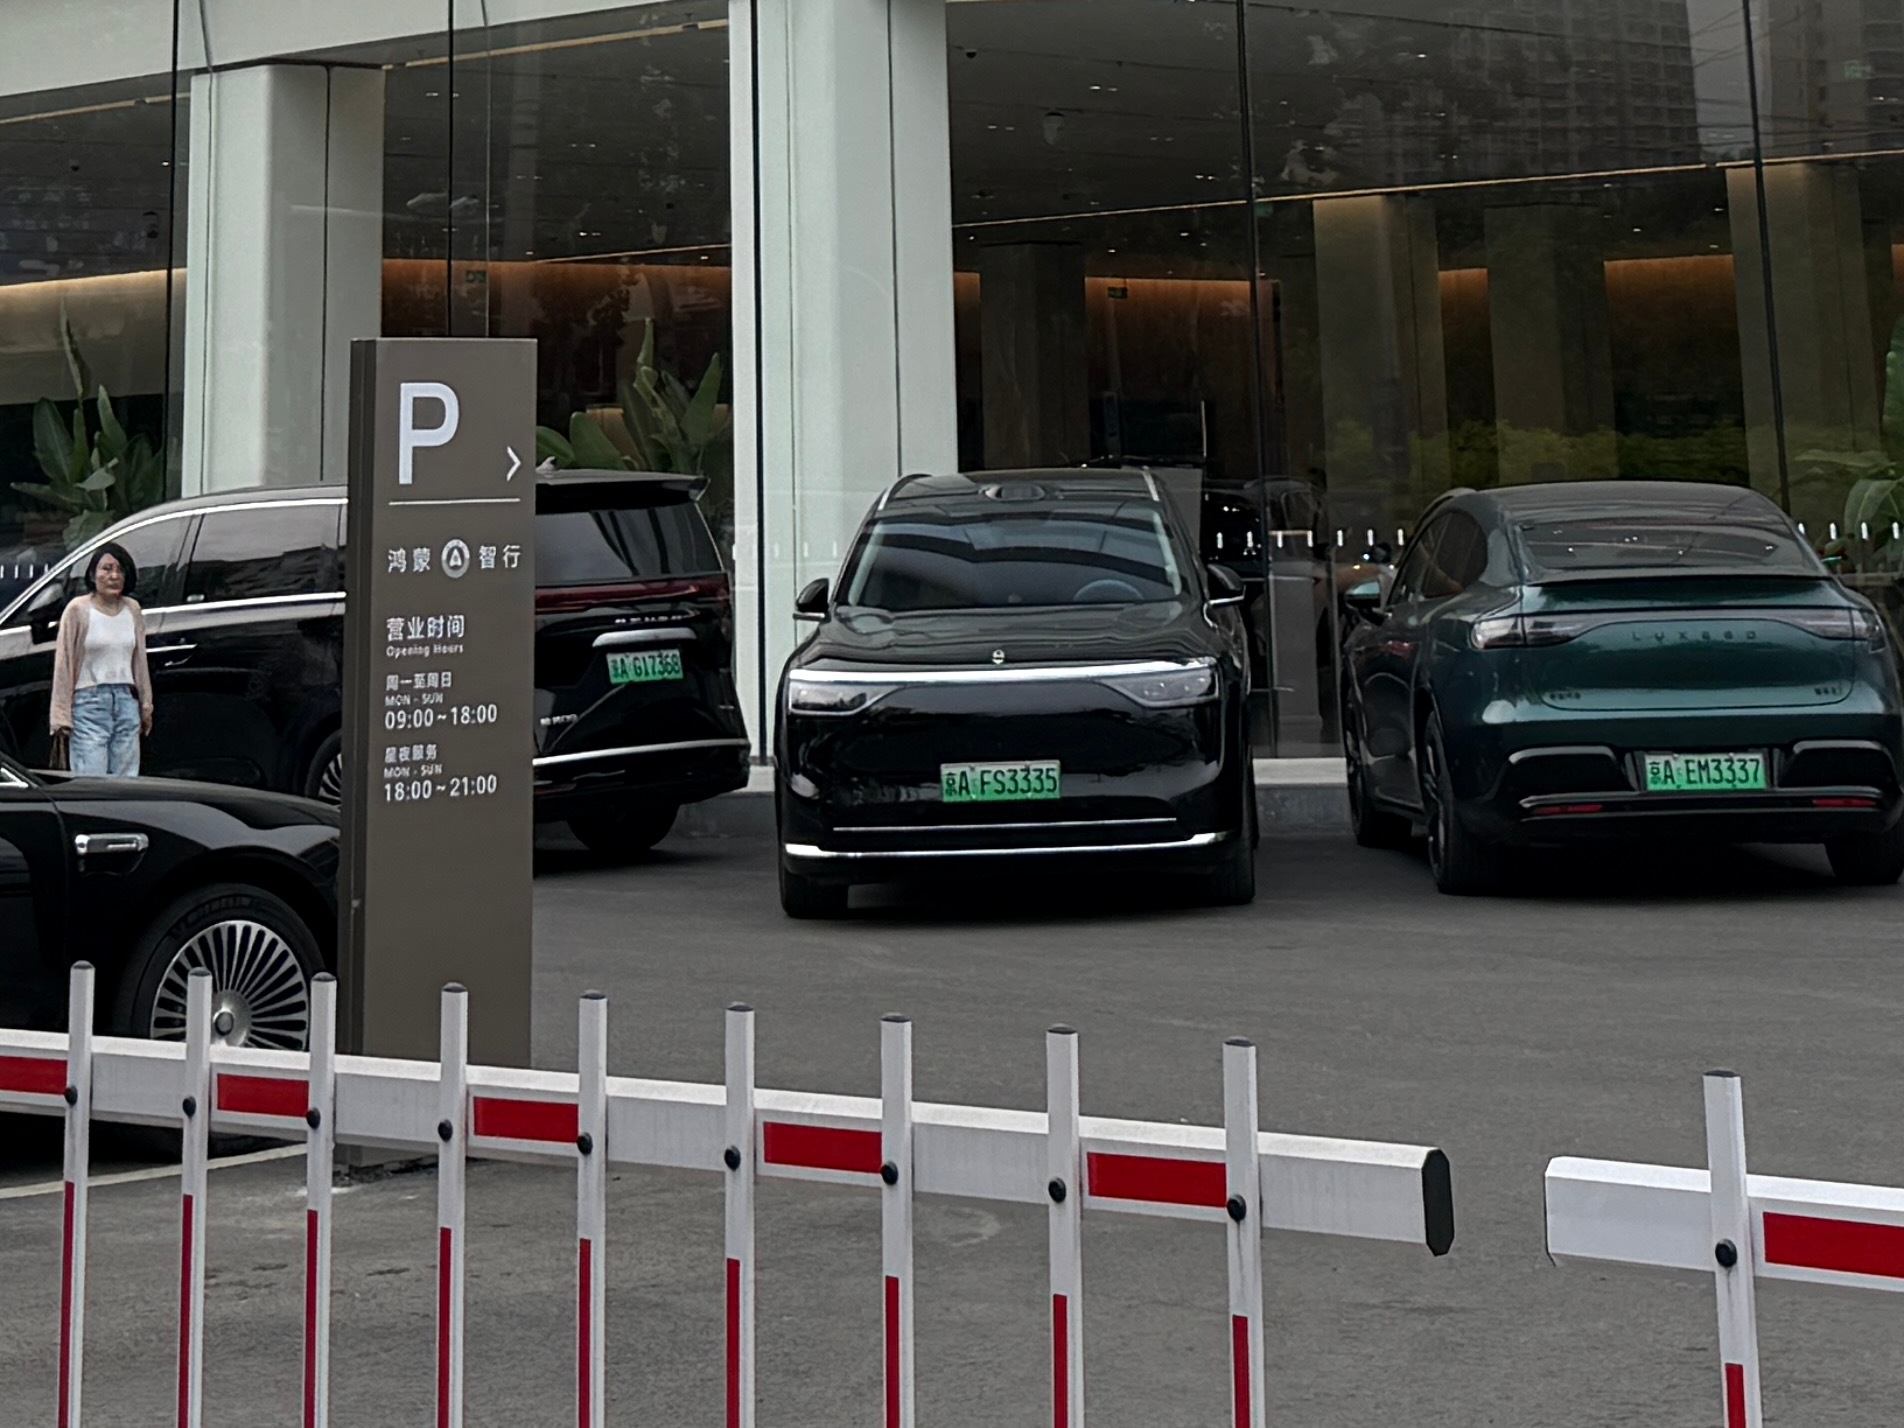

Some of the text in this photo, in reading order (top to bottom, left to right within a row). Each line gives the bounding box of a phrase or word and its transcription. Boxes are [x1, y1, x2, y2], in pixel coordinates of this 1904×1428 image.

[398, 382, 459, 484] P
[387, 544, 521, 574] 鸿蒙 智行
[386, 614, 465, 642] 营业时间
